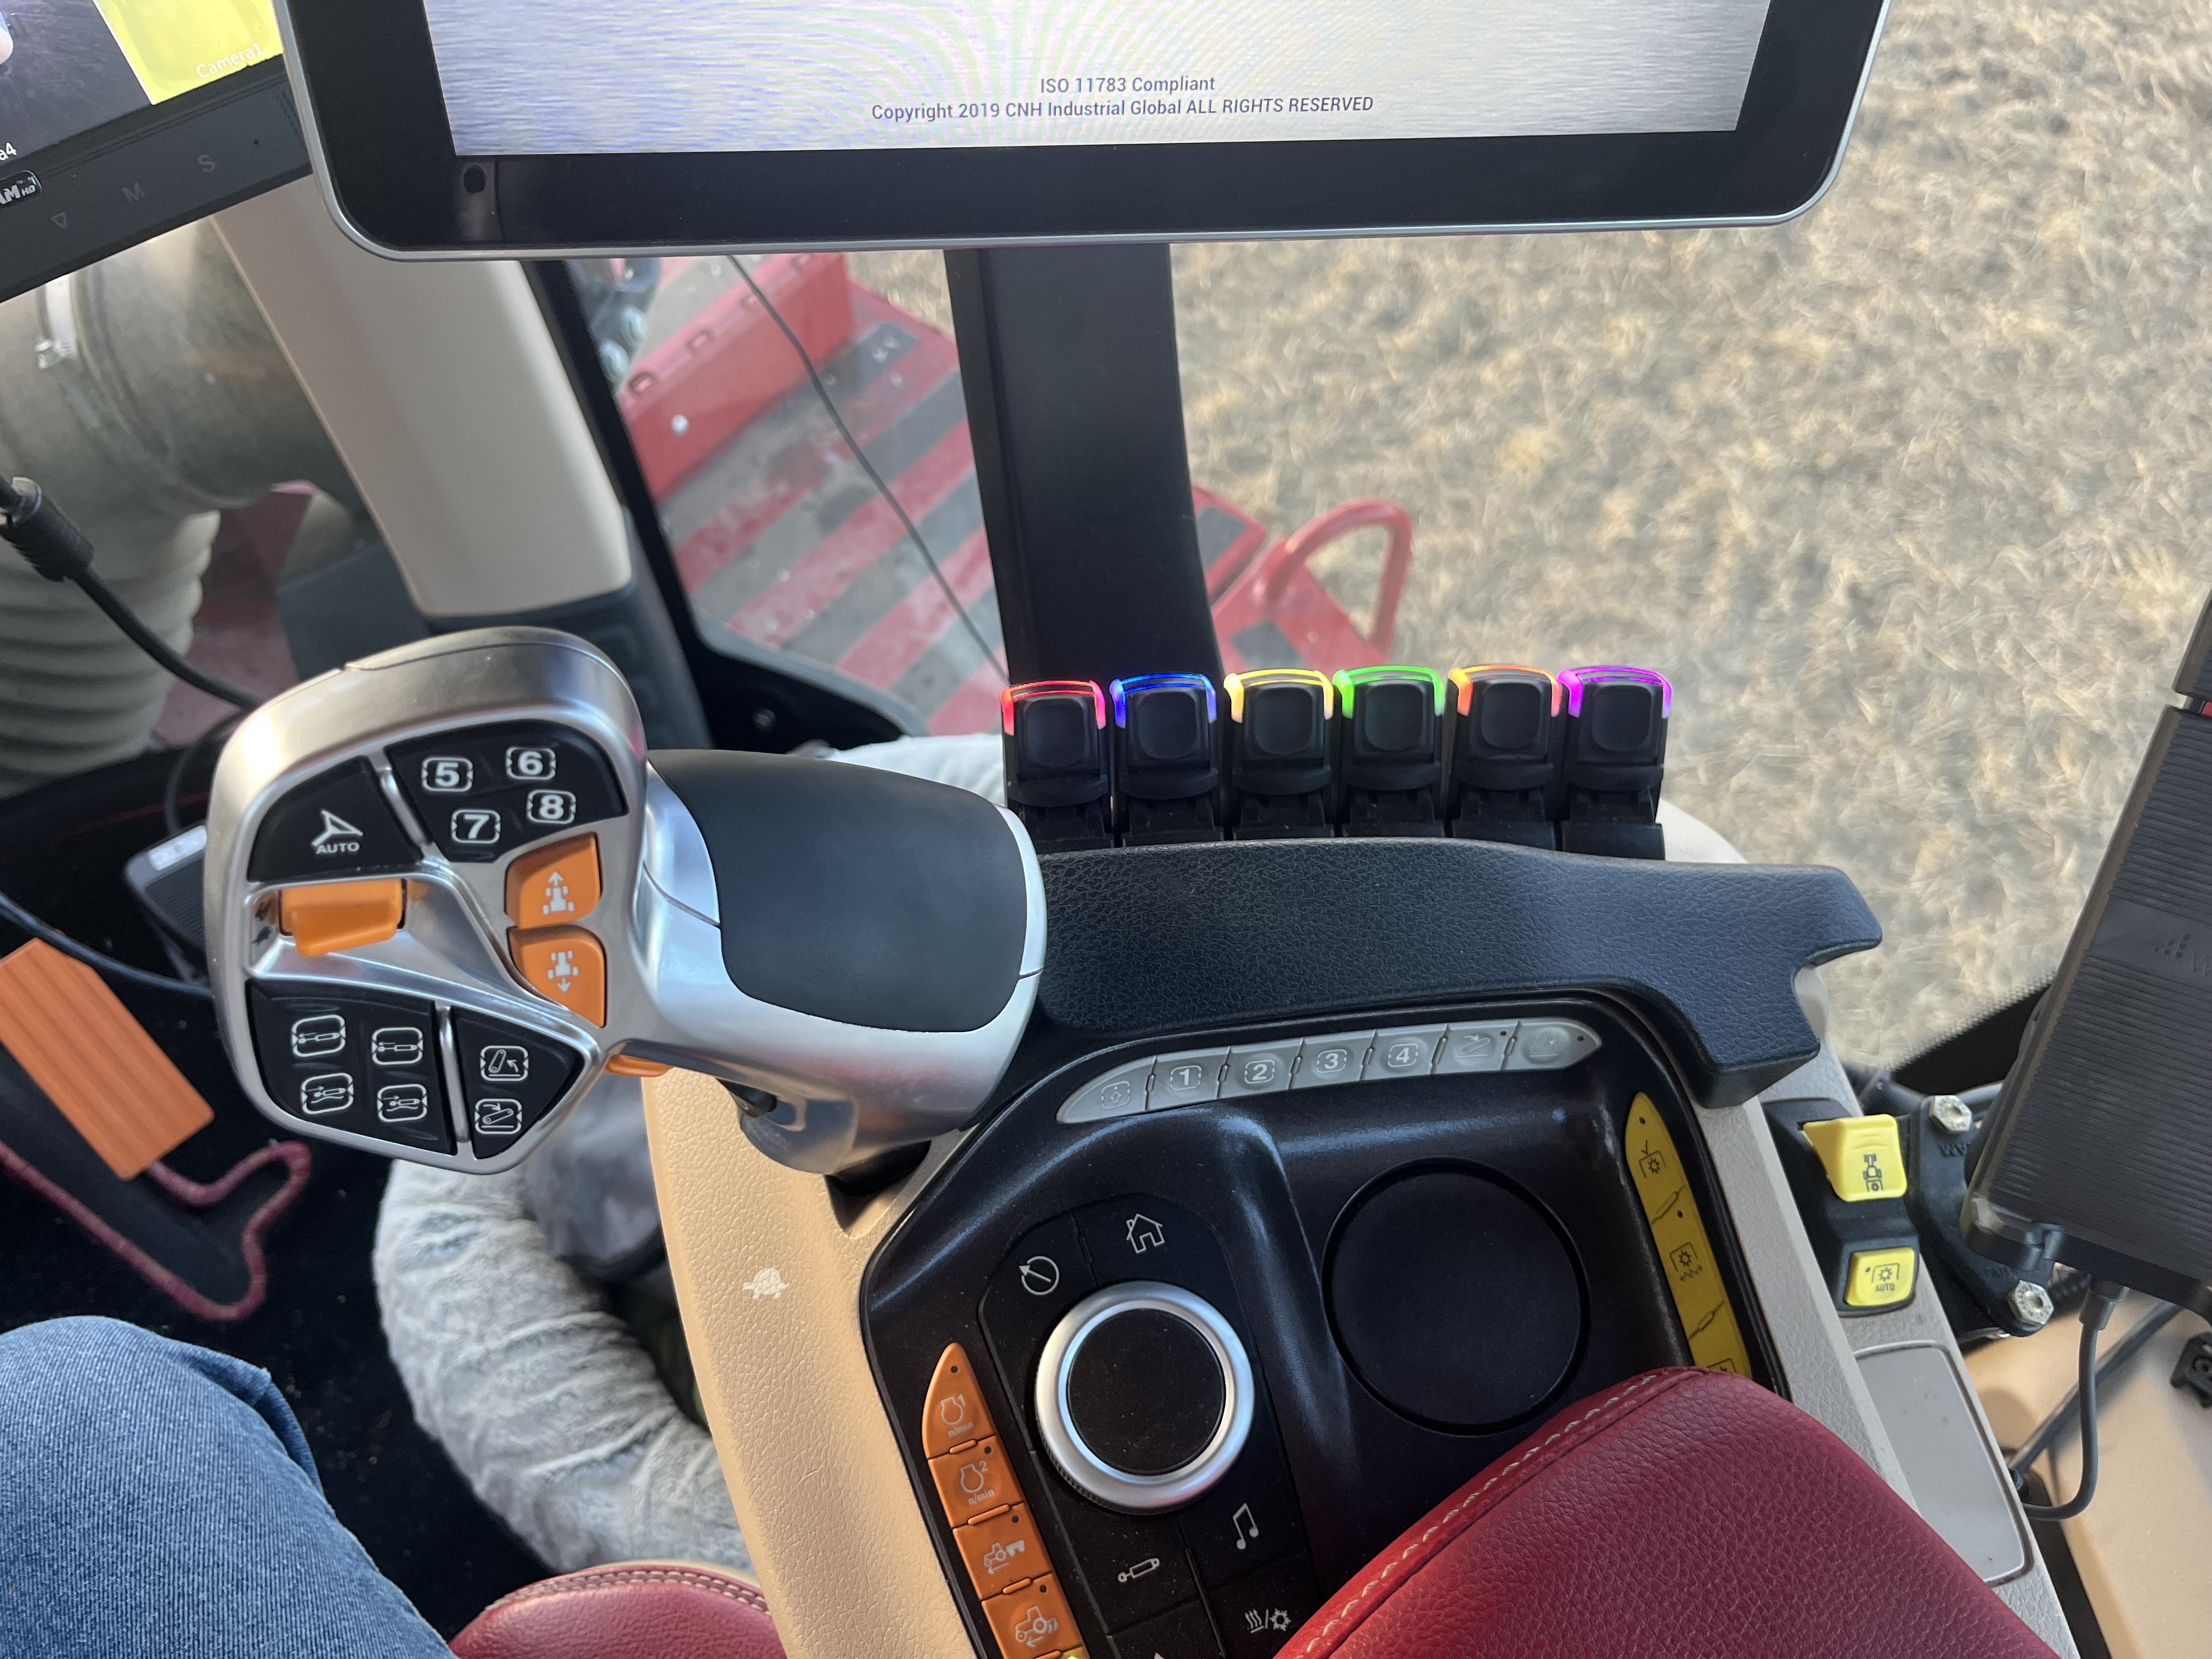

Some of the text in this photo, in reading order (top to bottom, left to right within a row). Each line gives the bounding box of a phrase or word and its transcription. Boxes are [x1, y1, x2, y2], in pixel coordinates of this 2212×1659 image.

[196, 42, 263, 77] Camera1
[1040, 76, 1215, 94] ISO 11783 Compliant
[872, 97, 1373, 122] Copyright 2019 CNH Industrial Global ALL RIGHTS RESERVED
[518, 752, 543, 775] 6
[435, 762, 460, 787] 5
[539, 794, 565, 819] 8
[464, 814, 490, 839] 7
[315, 842, 360, 855] AUTO
[1324, 1052, 1339, 1069] 3
[1396, 1047, 1410, 1064] 4
[1252, 1063, 1268, 1081] 2
[1875, 1283, 1895, 1293] AUTO
[968, 1487, 995, 1505] n/min
